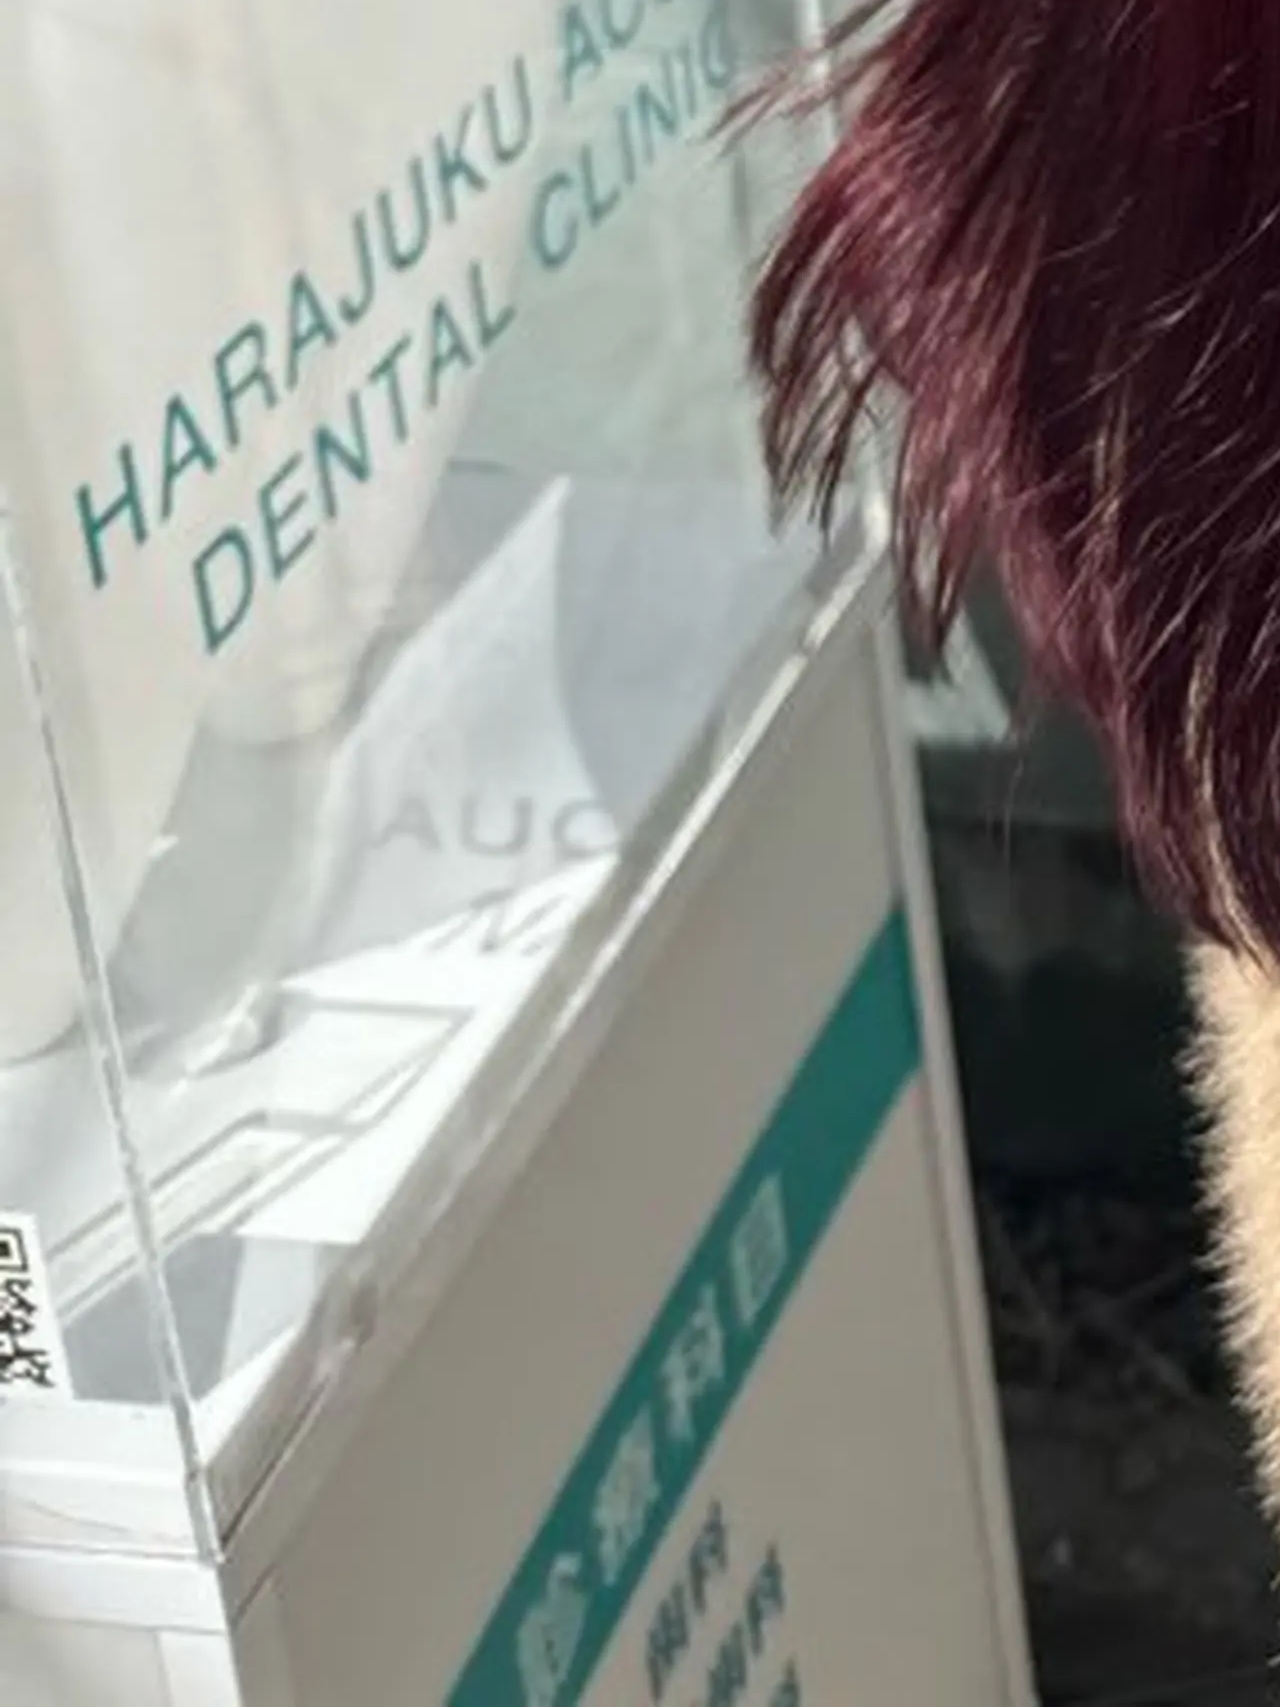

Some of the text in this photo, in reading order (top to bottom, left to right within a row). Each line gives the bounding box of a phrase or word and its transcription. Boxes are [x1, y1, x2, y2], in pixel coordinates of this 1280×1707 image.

[76, 55, 534, 589] HARAJUKU
[192, 7, 738, 655] DENTAL CLINIC
